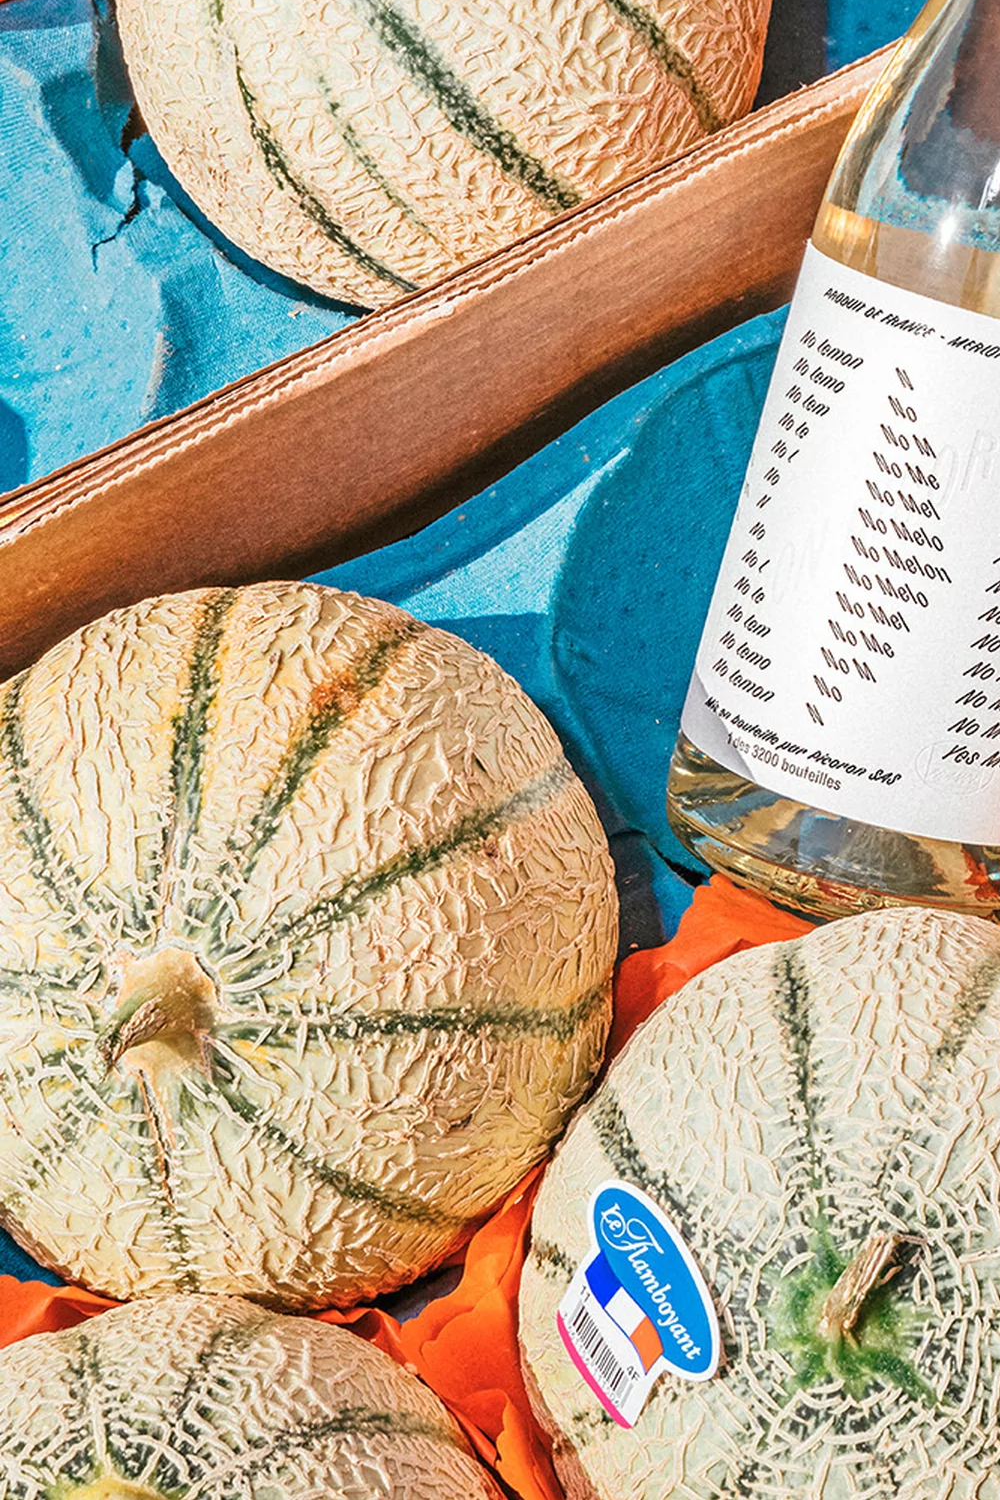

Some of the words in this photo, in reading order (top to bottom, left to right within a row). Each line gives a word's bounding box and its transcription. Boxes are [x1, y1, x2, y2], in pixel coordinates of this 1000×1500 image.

[823, 288, 866, 313] PRODUIT
[864, 306, 884, 320] DE
[880, 313, 936, 338] FRANCE
[800, 329, 816, 349] No
[792, 357, 809, 376] No
[785, 384, 802, 404] No
[887, 395, 918, 423] No
[778, 412, 795, 431] No
[880, 423, 910, 451] No
[770, 439, 788, 459] No
[763, 466, 780, 486] No
[872, 451, 903, 479] No
[904, 462, 940, 490] Me
[865, 479, 895, 507] No
[897, 490, 941, 521] Mel
[748, 521, 766, 541] No
[858, 507, 888, 535] No
[889, 518, 944, 552] Melo
[741, 549, 758, 568] No
[850, 535, 880, 563] No
[882, 546, 952, 584] Melon
[733, 576, 751, 596] No
[843, 563, 873, 591] No
[874, 574, 929, 608] Melo
[726, 603, 743, 623] No
[835, 590, 865, 619] No
[867, 602, 910, 633] Mel
[719, 630, 736, 650] No
[828, 619, 858, 647] No
[859, 630, 895, 659] Me
[712, 658, 729, 677] No
[820, 646, 850, 675] No
[962, 661, 996, 681] No
[813, 674, 843, 703] No
[954, 689, 988, 709] No
[947, 717, 980, 736] No
[730, 714, 780, 746] bouteille
[868, 768, 902, 786] SAS
[941, 744, 980, 766] Yes
[751, 744, 779, 768] 3200
[781, 758, 842, 791] bouteilles
[599, 1203, 626, 1242] Le
[620, 1217, 702, 1360] Flamboyant
